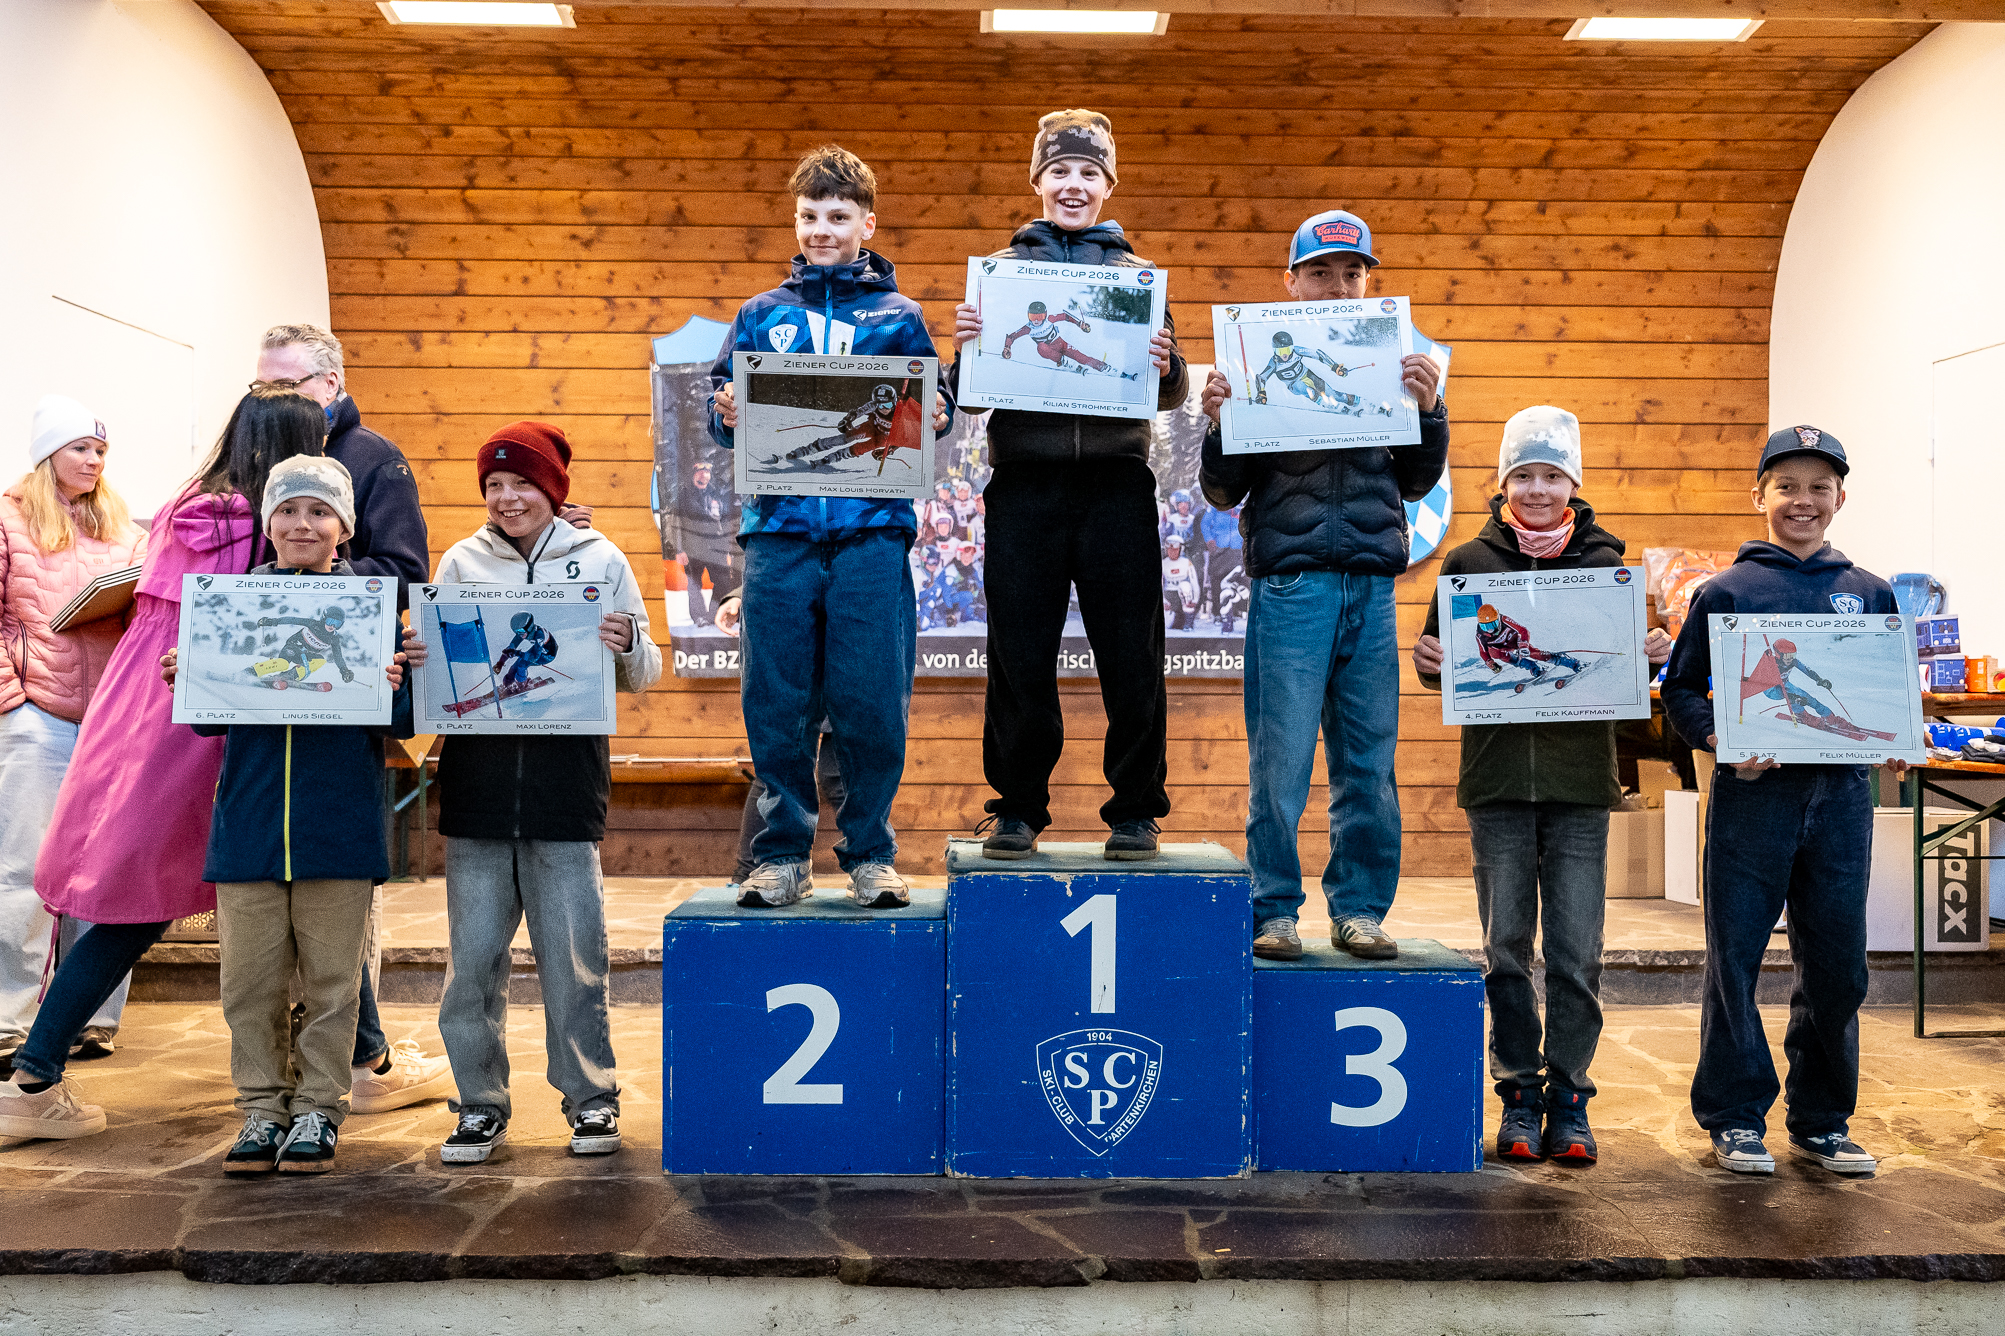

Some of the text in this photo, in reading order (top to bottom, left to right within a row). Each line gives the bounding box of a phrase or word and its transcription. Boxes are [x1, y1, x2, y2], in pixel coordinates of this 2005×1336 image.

[1315, 223, 1359, 237] Carhartt
[1016, 265, 1120, 281] ZIENER CUP 2026
[867, 308, 902, 318] ziener
[1260, 304, 1364, 318] ZIENER CUP 2026
[783, 360, 890, 371] ZIENER CUP 2026
[988, 396, 1015, 405] PLATZ
[1042, 400, 1070, 409] KILIAN
[1070, 402, 1128, 412] STROHMEYER
[1244, 434, 1391, 449] 3. PLATZ SEBASTIAN MÜLLER
[839, 486, 864, 494] LOUIS
[235, 580, 347, 590] ZIENER CUP 2026
[1487, 574, 1596, 588] ZIENER CUP 2026
[459, 590, 565, 599] ZIENER CUP 2026
[1759, 619, 1867, 628] ZIENER CUP 2026
[674, 650, 710, 670] Der
[922, 652, 960, 670] von
[964, 649, 988, 670] de
[1163, 649, 1245, 676] gspitzba
[206, 712, 236, 720] PLATZ
[282, 712, 309, 720] LINUS
[310, 712, 344, 720] SIEGEL
[1475, 712, 1502, 720] PLATZ
[1534, 710, 1560, 718] FELIX
[1560, 709, 1616, 717] KAUFFMANN
[1845, 751, 1882, 759] MÜLLER
[1943, 831, 1975, 936] Tacx
[1060, 893, 1117, 1014] 1
[1086, 1031, 1113, 1042] 1904
[762, 982, 844, 1106] 2
[1330, 1006, 1408, 1128] 3
[1086, 1089, 1118, 1125] P
